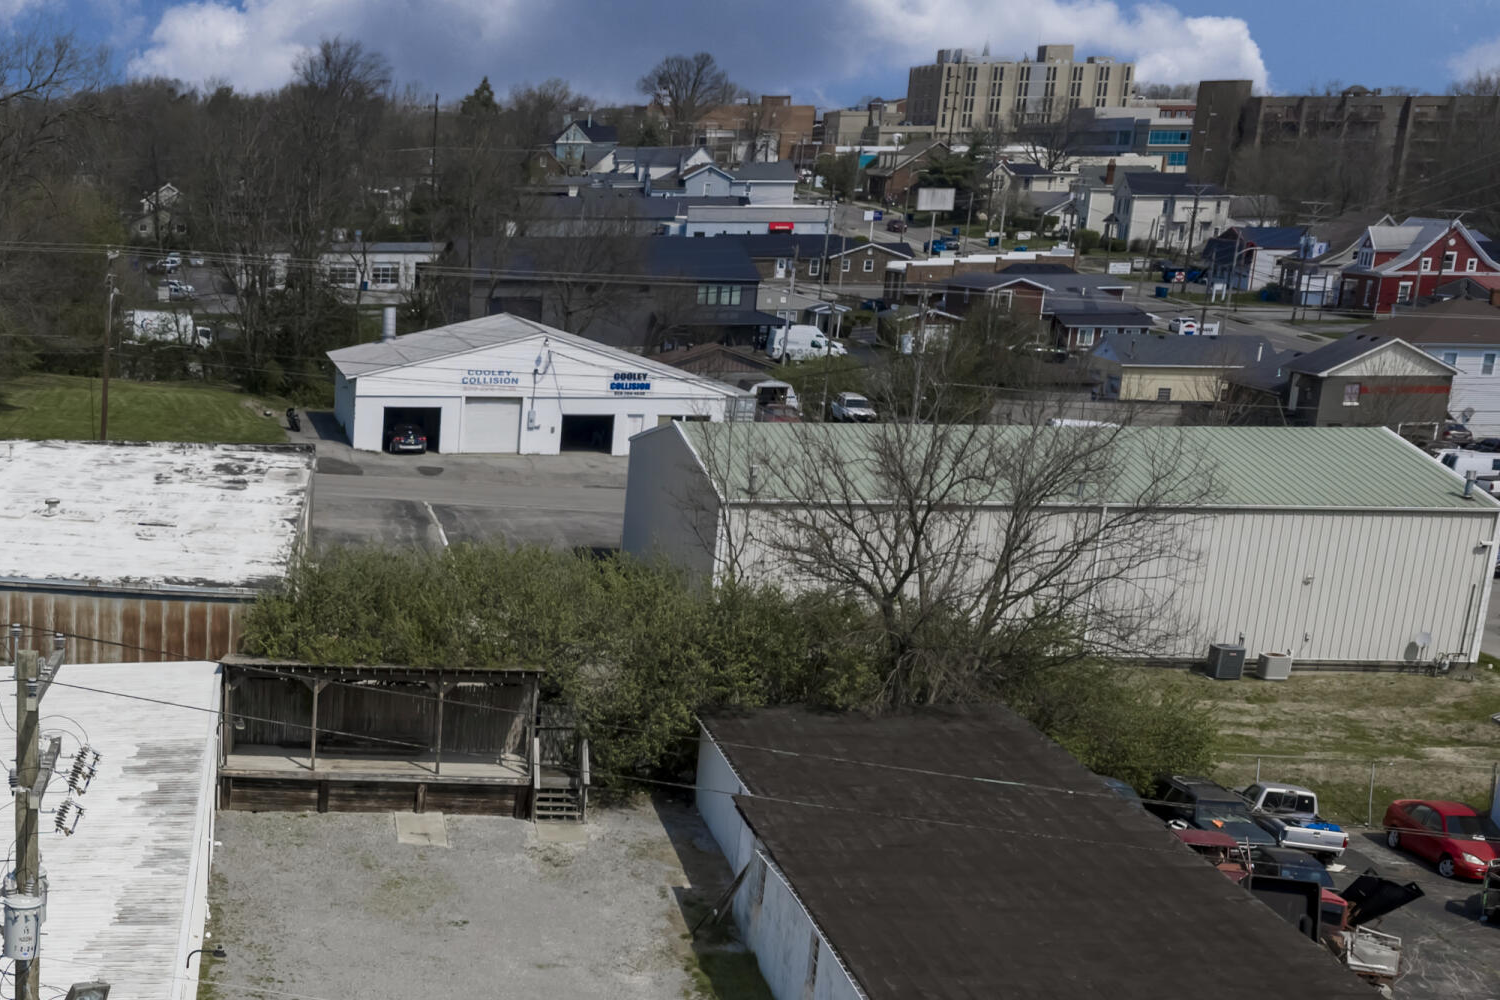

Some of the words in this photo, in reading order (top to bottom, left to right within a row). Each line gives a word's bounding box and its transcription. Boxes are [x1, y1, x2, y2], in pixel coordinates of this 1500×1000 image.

[461, 376, 519, 384] COLLISION
[613, 372, 648, 381] COOLEY
[610, 382, 650, 390] COLLISION
